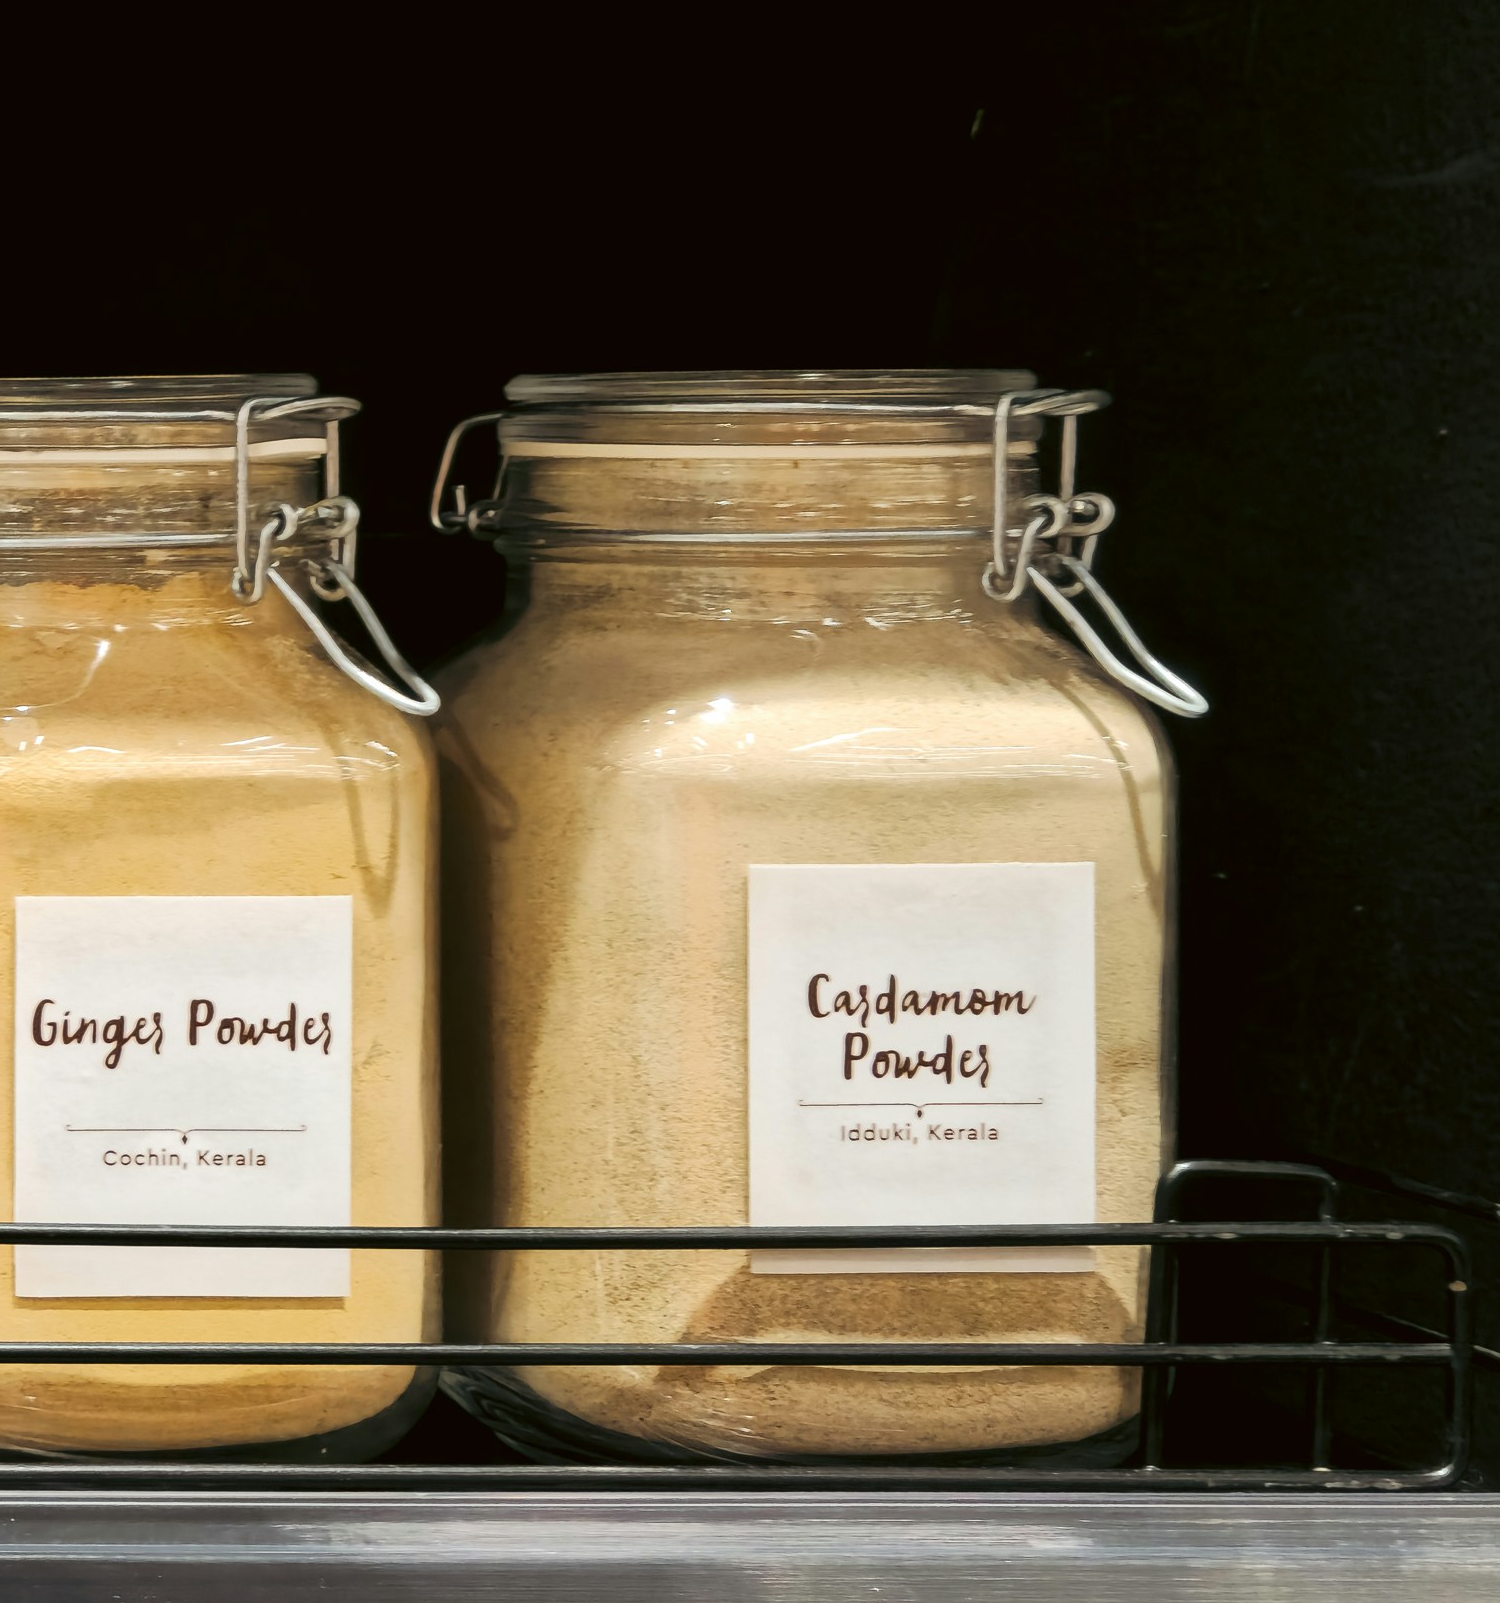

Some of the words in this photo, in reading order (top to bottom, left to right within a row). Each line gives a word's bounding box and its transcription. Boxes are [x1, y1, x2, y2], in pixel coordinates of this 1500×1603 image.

[807, 973, 1037, 1027] Cardamom
[32, 999, 163, 1069] Ginger
[188, 999, 332, 1055] Powder
[843, 1032, 991, 1088] Powder
[101, 1148, 188, 1170] Cochin,
[197, 1148, 268, 1166] Kerala
[840, 1123, 918, 1145] Idduki,
[927, 1123, 999, 1140] Kerala
